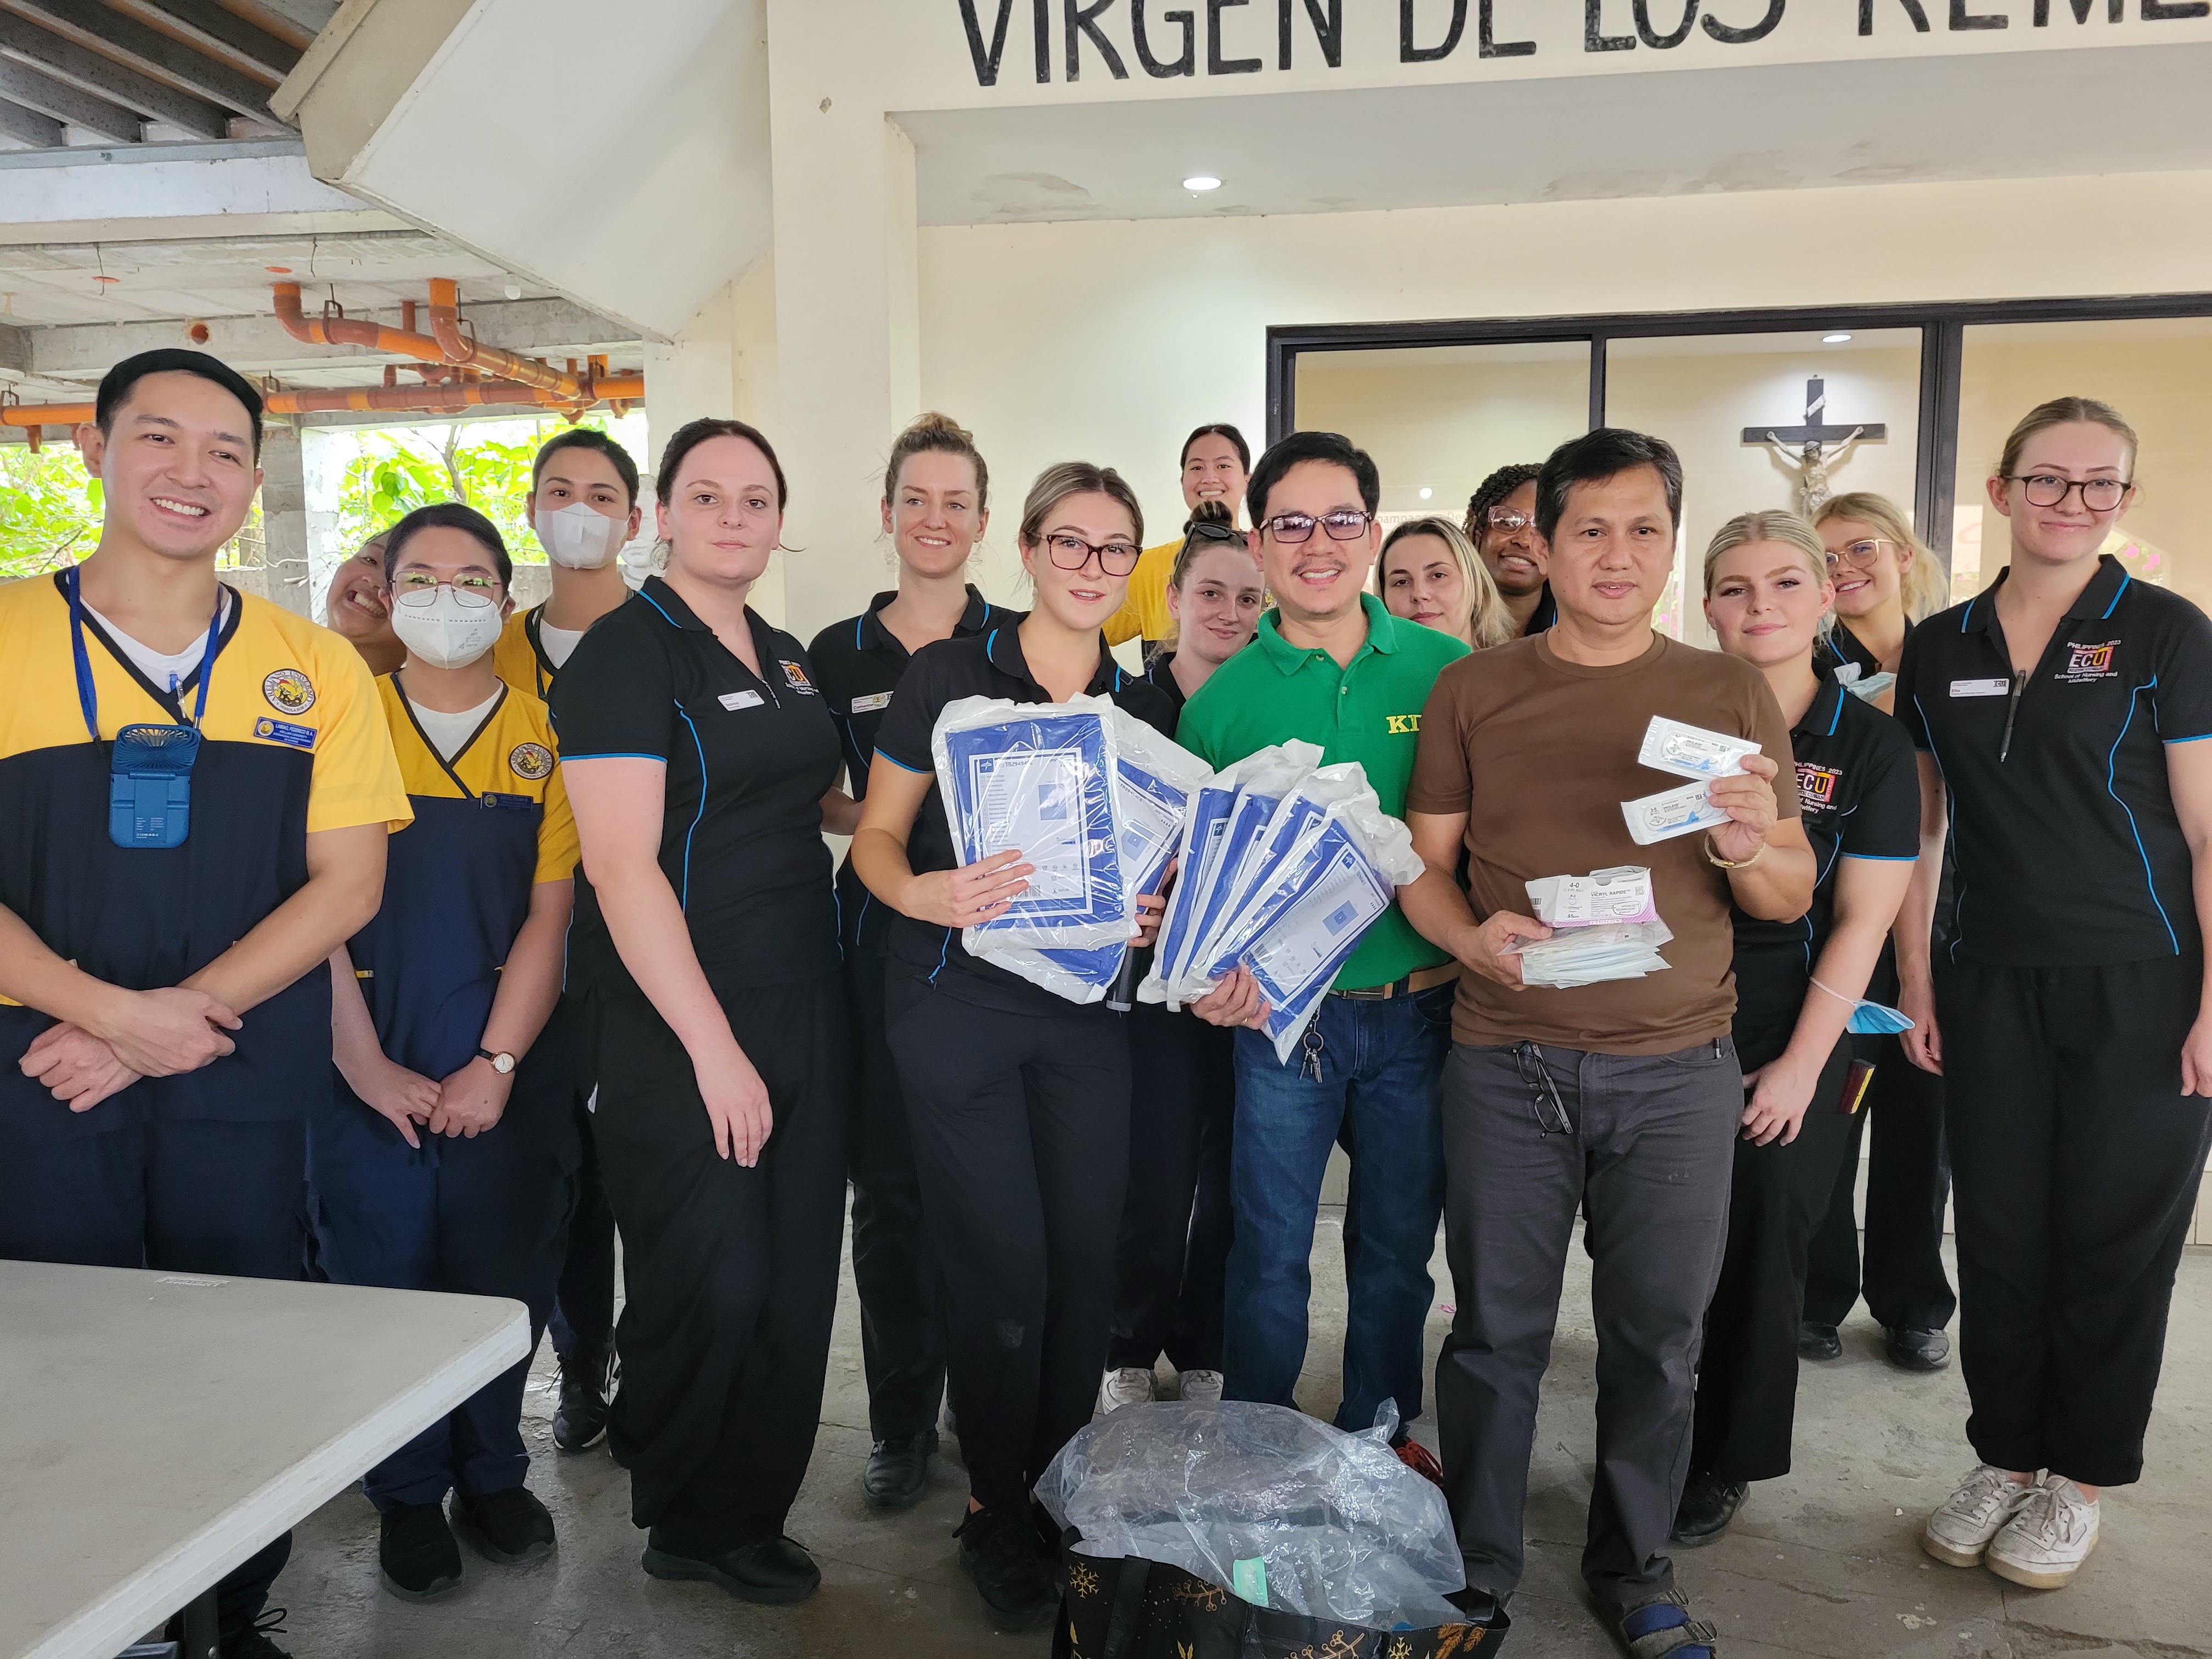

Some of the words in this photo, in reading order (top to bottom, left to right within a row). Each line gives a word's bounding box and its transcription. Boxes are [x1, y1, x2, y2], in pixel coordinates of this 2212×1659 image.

[2069, 651, 2104, 668] ECU
[1796, 773, 1827, 793] ECU
[1804, 799, 1826, 809] Nursing
